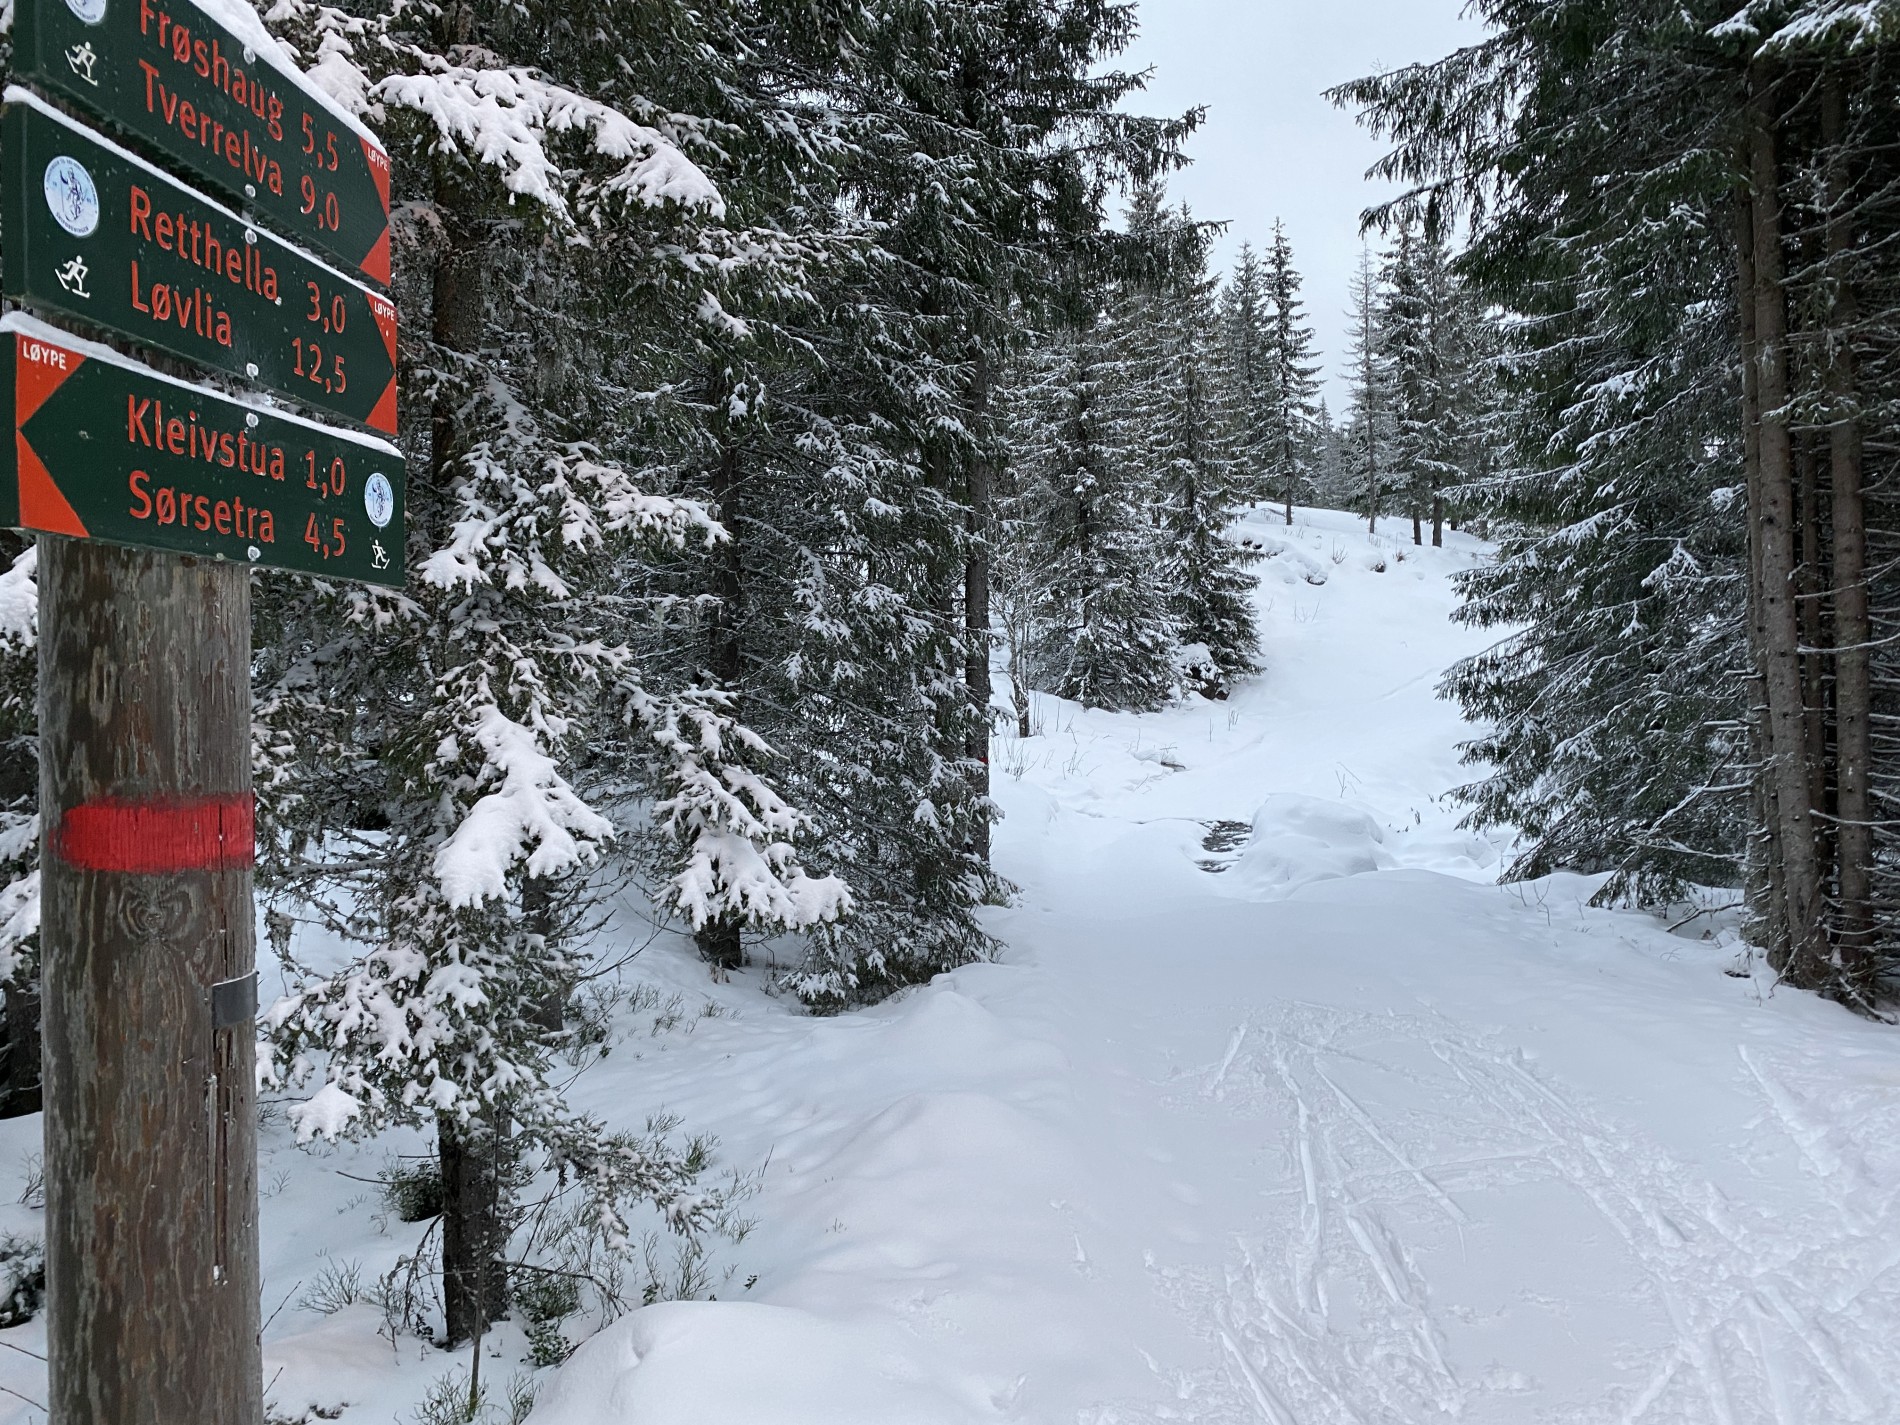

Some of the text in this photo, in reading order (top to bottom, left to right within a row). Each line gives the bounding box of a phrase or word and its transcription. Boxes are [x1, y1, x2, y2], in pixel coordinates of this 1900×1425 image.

[140, 0, 339, 173] Frøshaug 5,5
[139, 60, 283, 197] Tverrelva
[300, 175, 339, 232] 9,0
[367, 146, 389, 172] LØYPE
[130, 186, 346, 333] Retthella 3,0
[374, 300, 395, 321] LØYPE
[23, 341, 67, 371] LØYPE
[131, 260, 347, 393] Løvlia 12,5
[128, 394, 285, 481] Kleivstua
[305, 450, 346, 499] 1,0
[129, 470, 346, 560] Sørsetra 4,5
